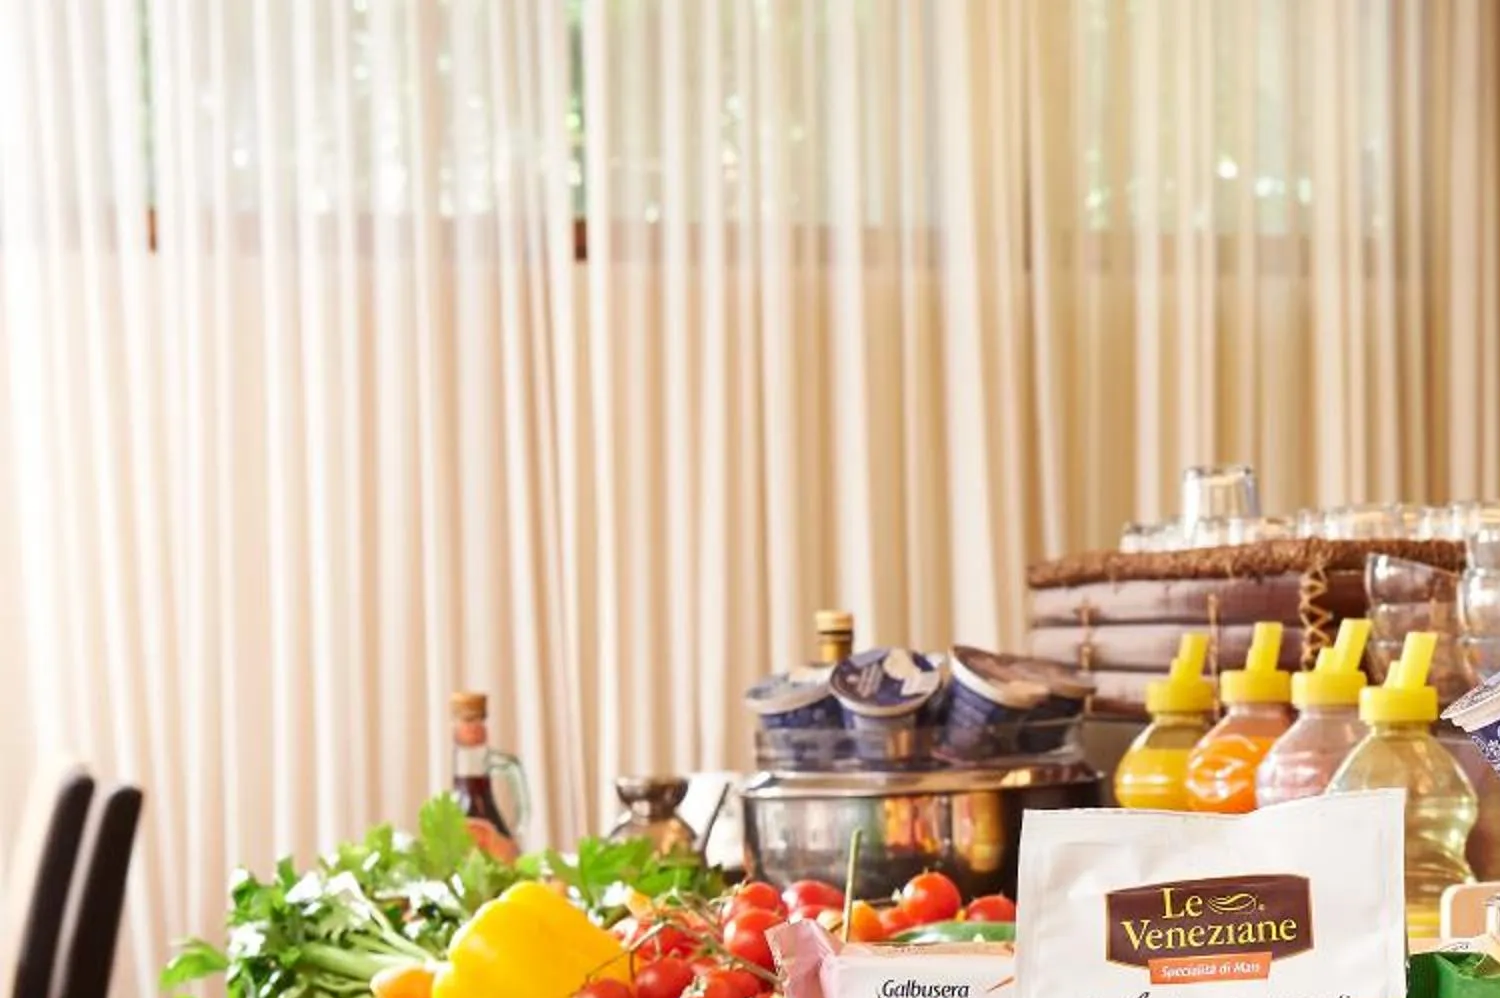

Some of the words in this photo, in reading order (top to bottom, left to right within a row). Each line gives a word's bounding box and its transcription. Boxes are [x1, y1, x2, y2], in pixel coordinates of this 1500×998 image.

[1160, 887, 1203, 920] Le
[1120, 917, 1298, 951] Veneziane
[882, 979, 971, 998] Galbusera
